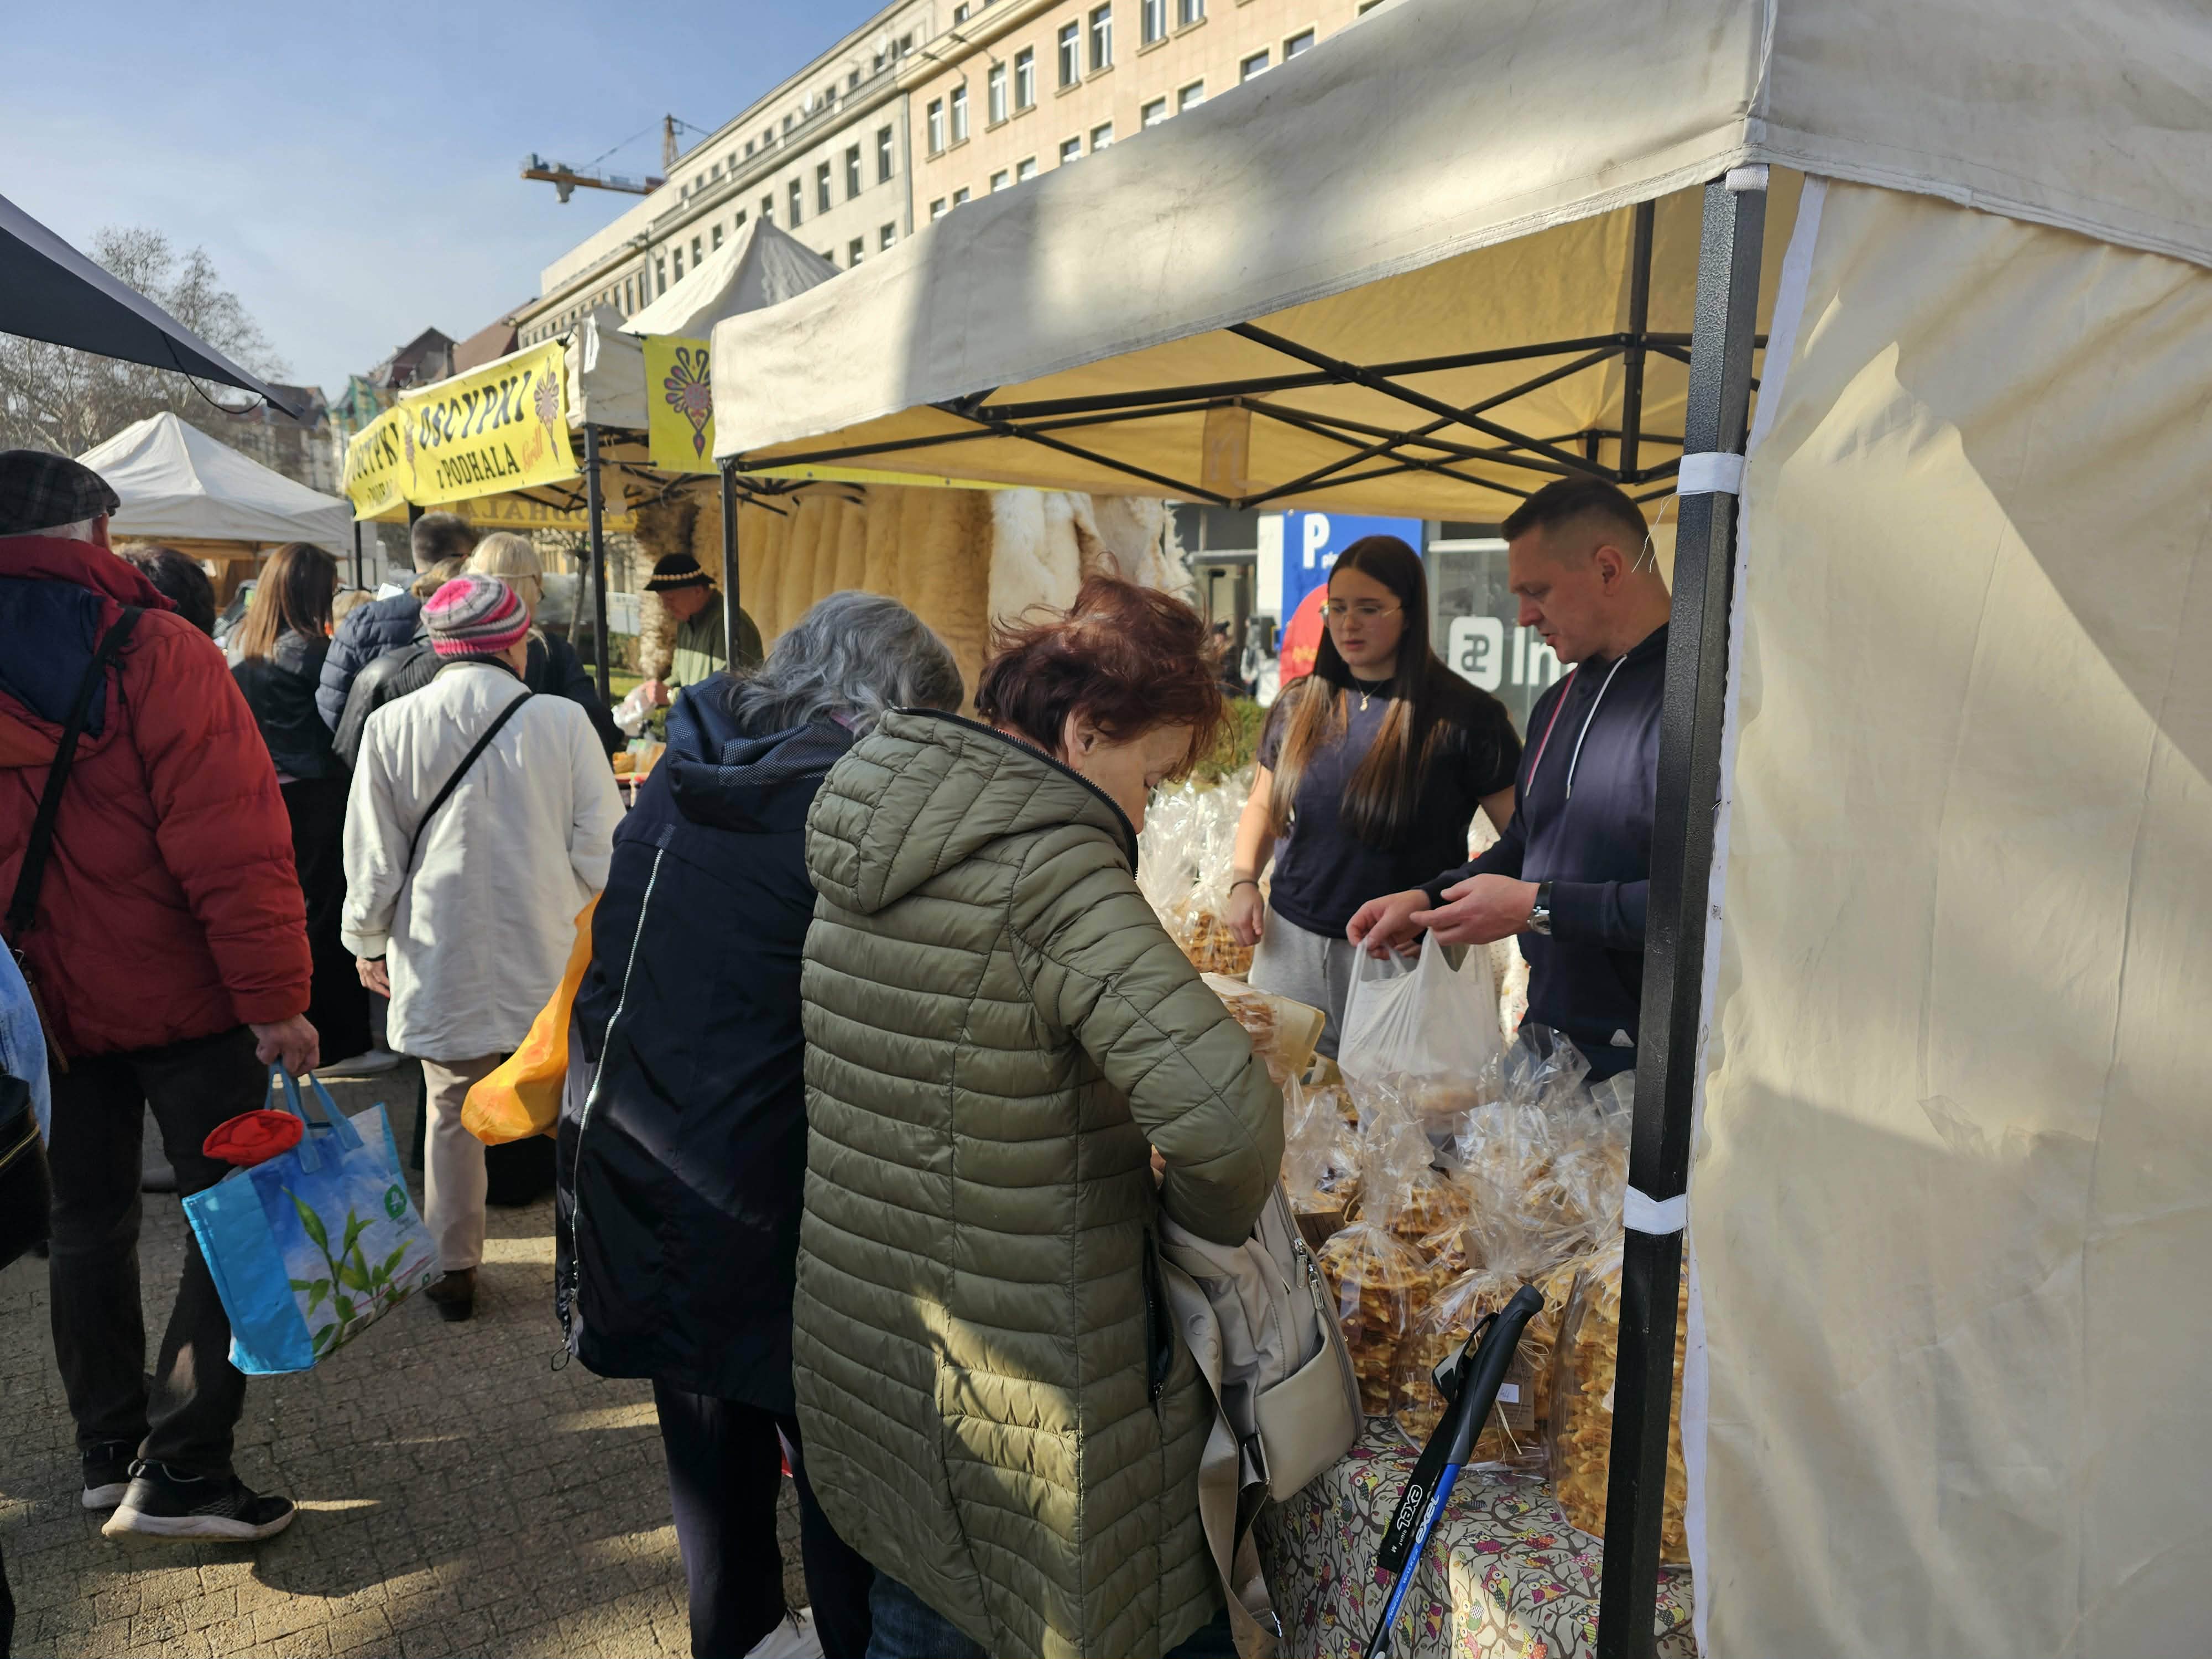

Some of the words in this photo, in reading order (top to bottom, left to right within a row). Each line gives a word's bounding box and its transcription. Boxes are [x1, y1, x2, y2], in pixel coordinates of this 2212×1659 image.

[420, 370, 532, 450] OSCYPKI
[441, 442, 520, 487] PODHALA
[522, 424, 543, 474] Grill
[1303, 513, 1330, 569] P
[1391, 1545, 1397, 1553] M
